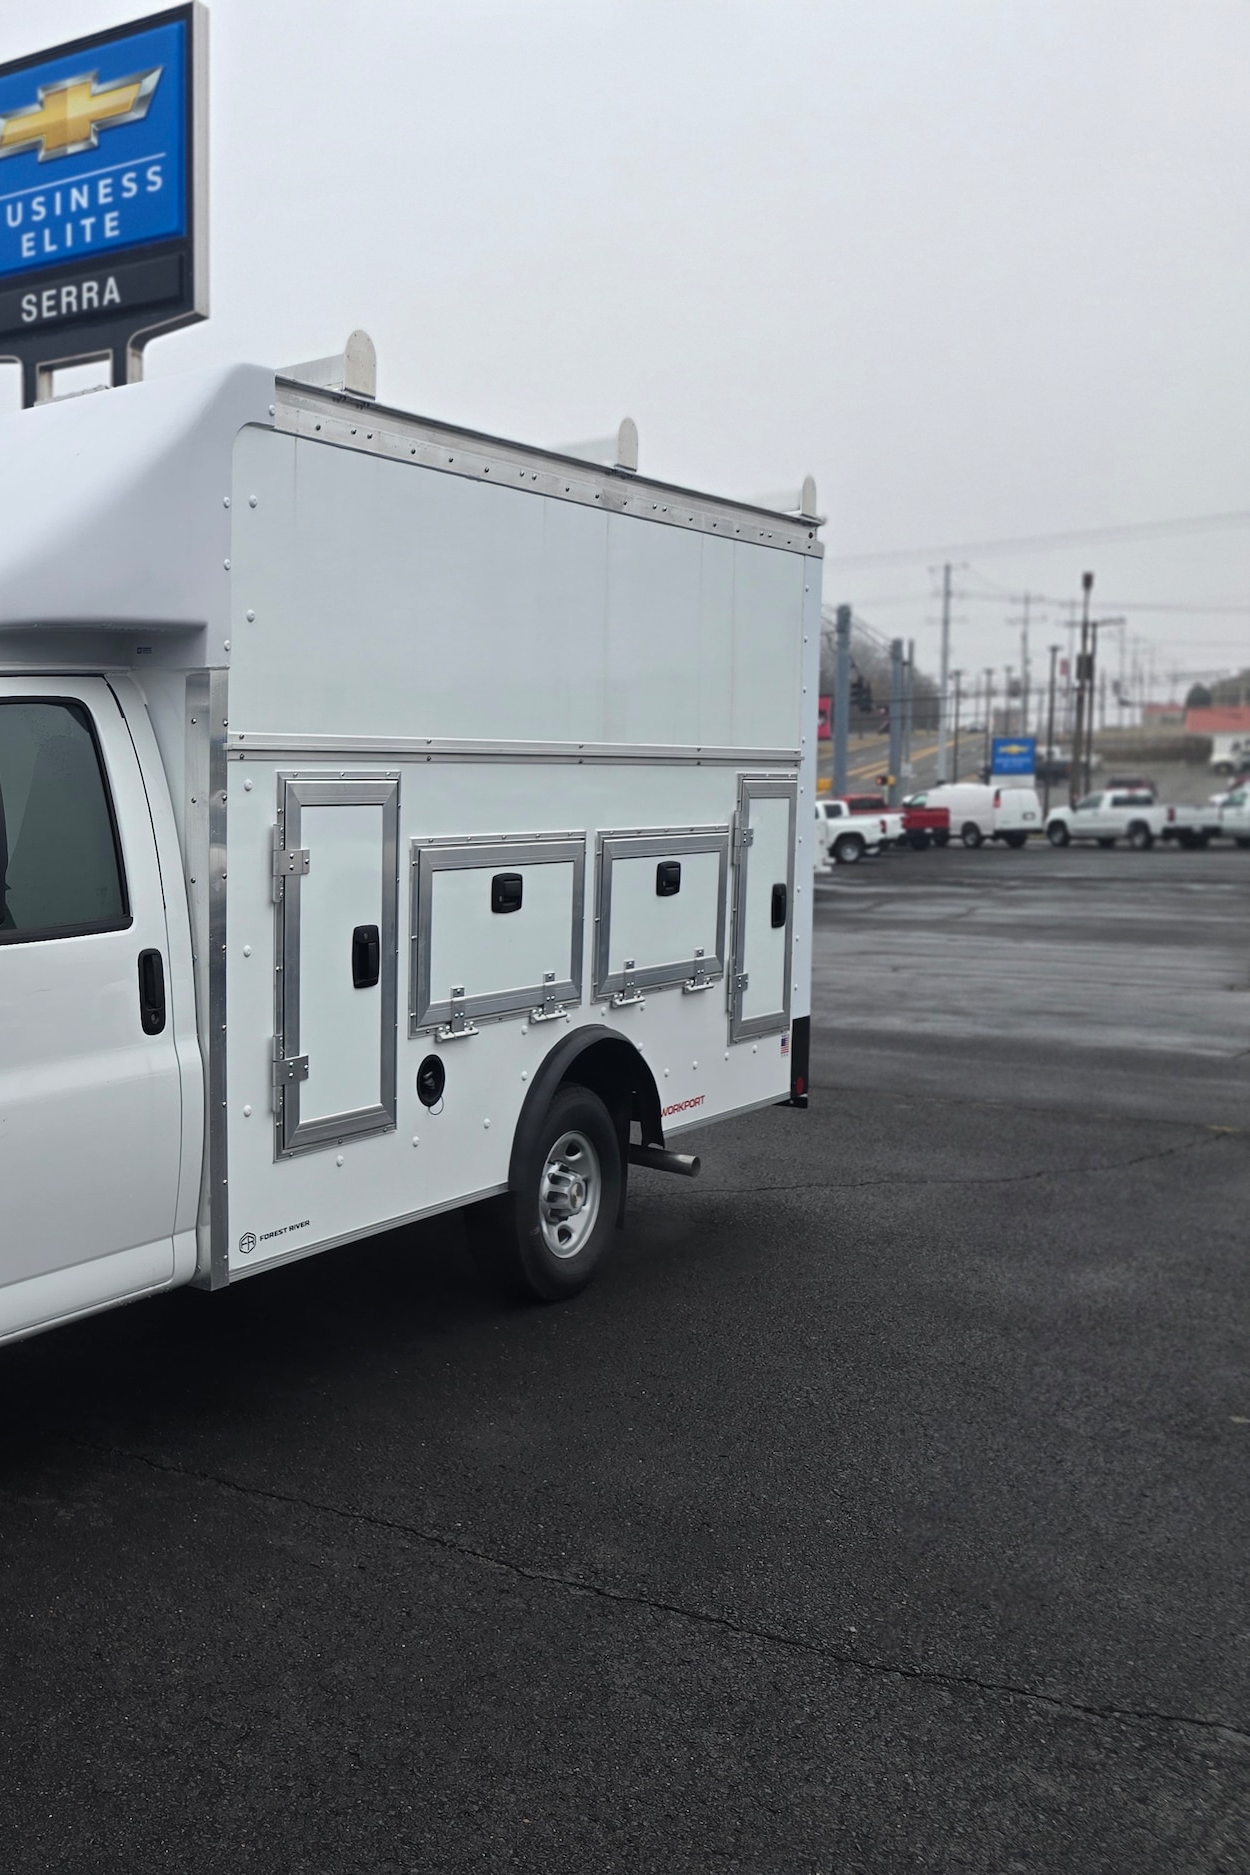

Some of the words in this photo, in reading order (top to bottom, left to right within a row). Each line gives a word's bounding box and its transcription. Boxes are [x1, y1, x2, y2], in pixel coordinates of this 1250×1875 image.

[21, 211, 121, 258] ELITE
[21, 276, 121, 322] SERRA
[259, 1227, 288, 1242] FOREST
[288, 1219, 311, 1232] RIVER
